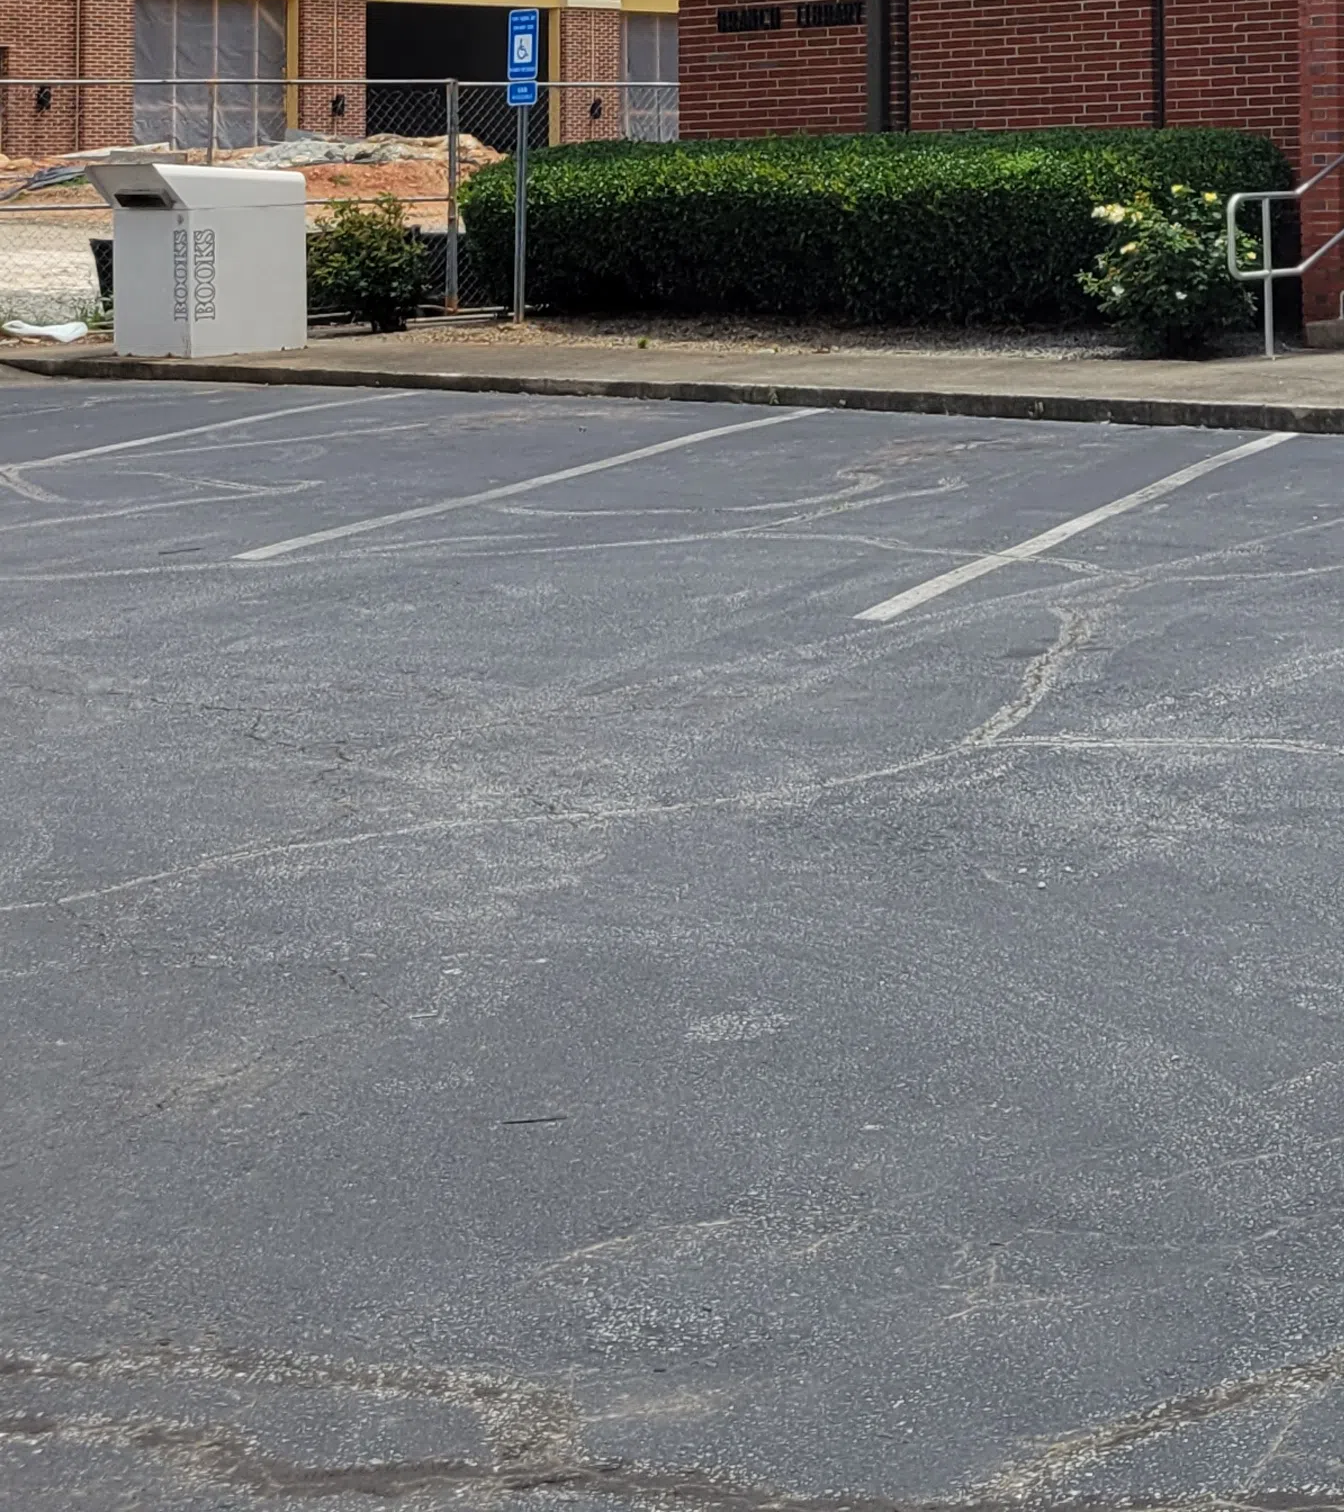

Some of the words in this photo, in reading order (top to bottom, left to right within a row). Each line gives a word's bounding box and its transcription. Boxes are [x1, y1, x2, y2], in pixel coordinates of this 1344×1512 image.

[797, 0, 863, 28] LIBRARY
[174, 229, 188, 322] BOOKS
[194, 228, 215, 322] BOOKS
